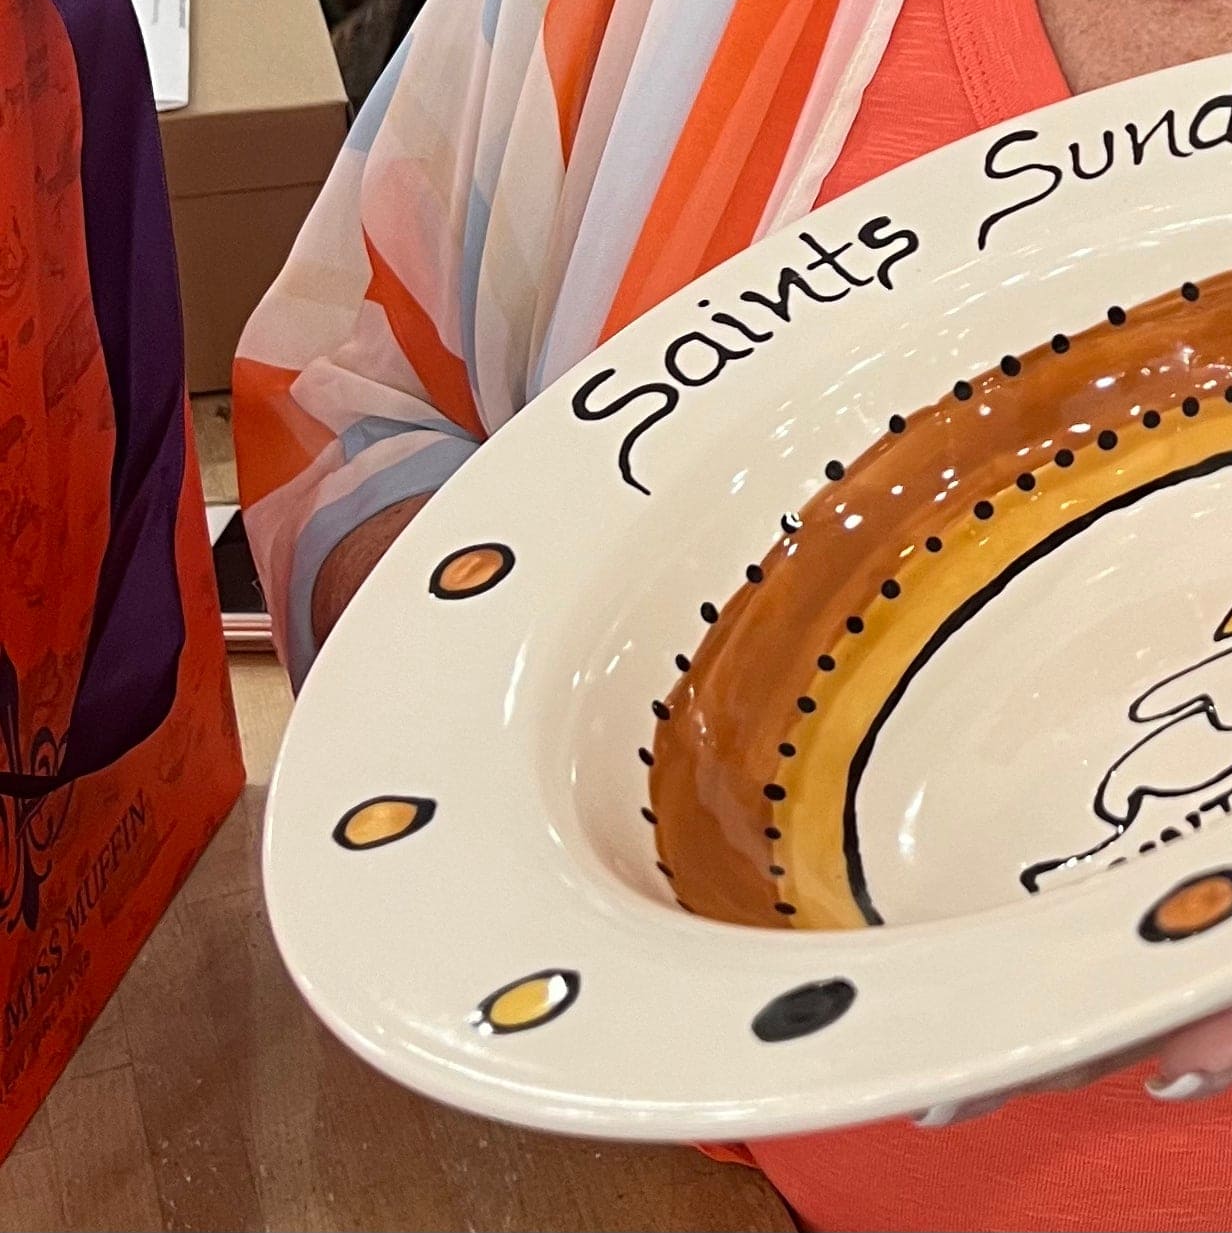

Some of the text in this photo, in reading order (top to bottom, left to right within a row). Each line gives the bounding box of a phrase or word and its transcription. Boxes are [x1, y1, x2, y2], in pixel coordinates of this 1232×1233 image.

[572, 215, 919, 496] Saints
[4, 787, 149, 1049] MISS MUFFIN
